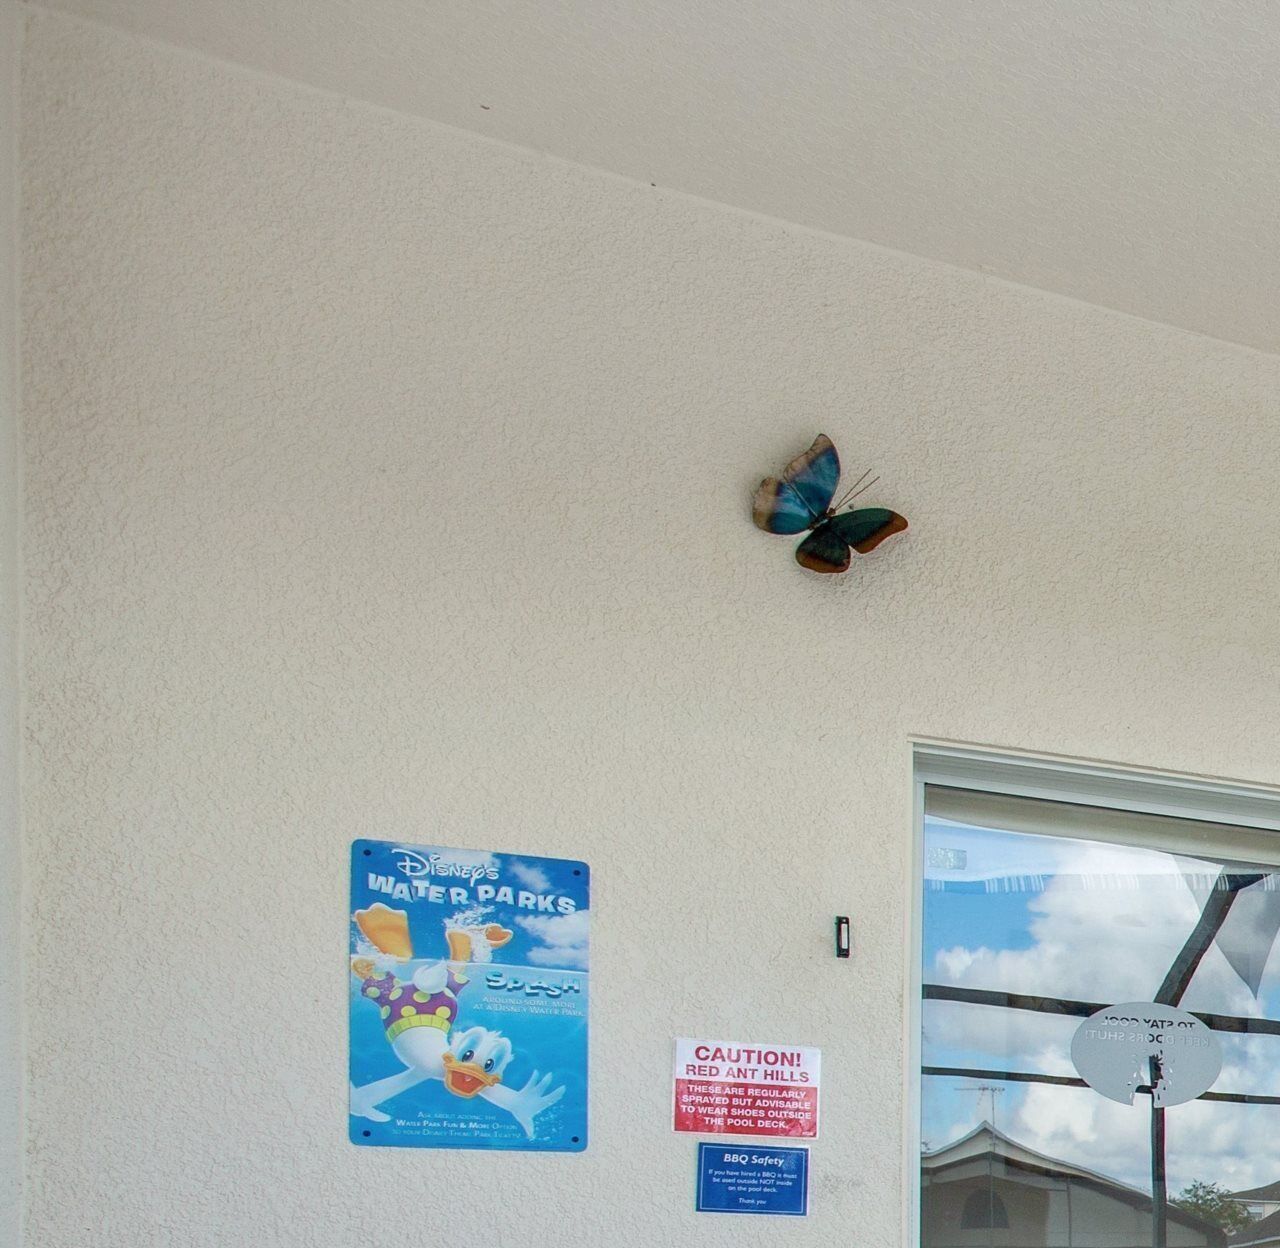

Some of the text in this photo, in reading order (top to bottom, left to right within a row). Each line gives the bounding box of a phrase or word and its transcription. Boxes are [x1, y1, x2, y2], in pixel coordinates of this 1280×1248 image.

[392, 849, 499, 886] Disney's
[368, 872, 576, 914] WATER PARKS
[486, 970, 580, 998] SPLASH
[695, 1046, 801, 1067] CAUTION!
[686, 1064, 809, 1082] RED ANT HILLS
[688, 1085, 806, 1099] THESE ARE REGULARLY
[682, 1095, 811, 1109] SPRAYED BUT ADVISABLE
[681, 1105, 811, 1119] TO WEAR SHOES OUTSIDE
[704, 1117, 788, 1128] THE POOL DECK.
[723, 1153, 784, 1167] BBQ Safety
